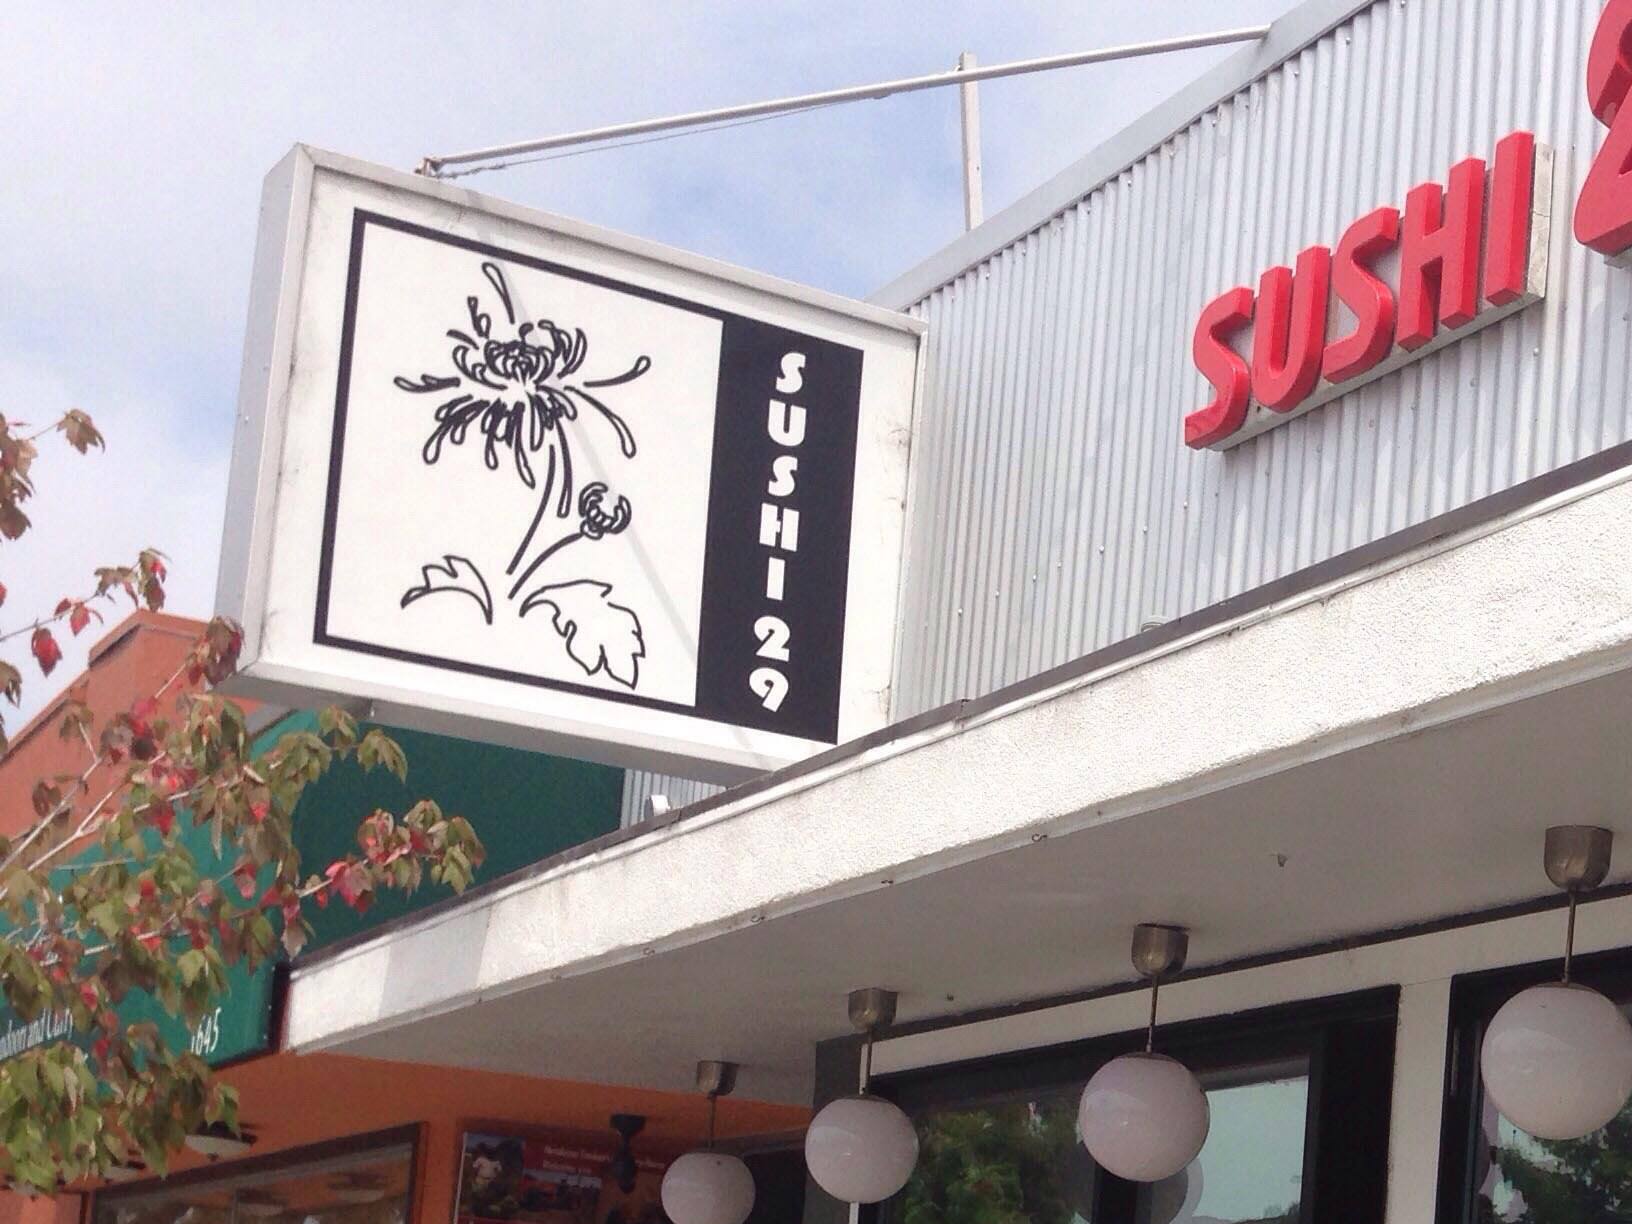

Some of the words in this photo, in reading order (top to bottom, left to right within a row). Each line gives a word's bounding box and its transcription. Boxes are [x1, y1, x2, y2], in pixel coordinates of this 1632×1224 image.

[1184, 131, 1538, 446] SUSHI
[756, 352, 807, 602] SUSHI
[749, 615, 791, 713] 29
